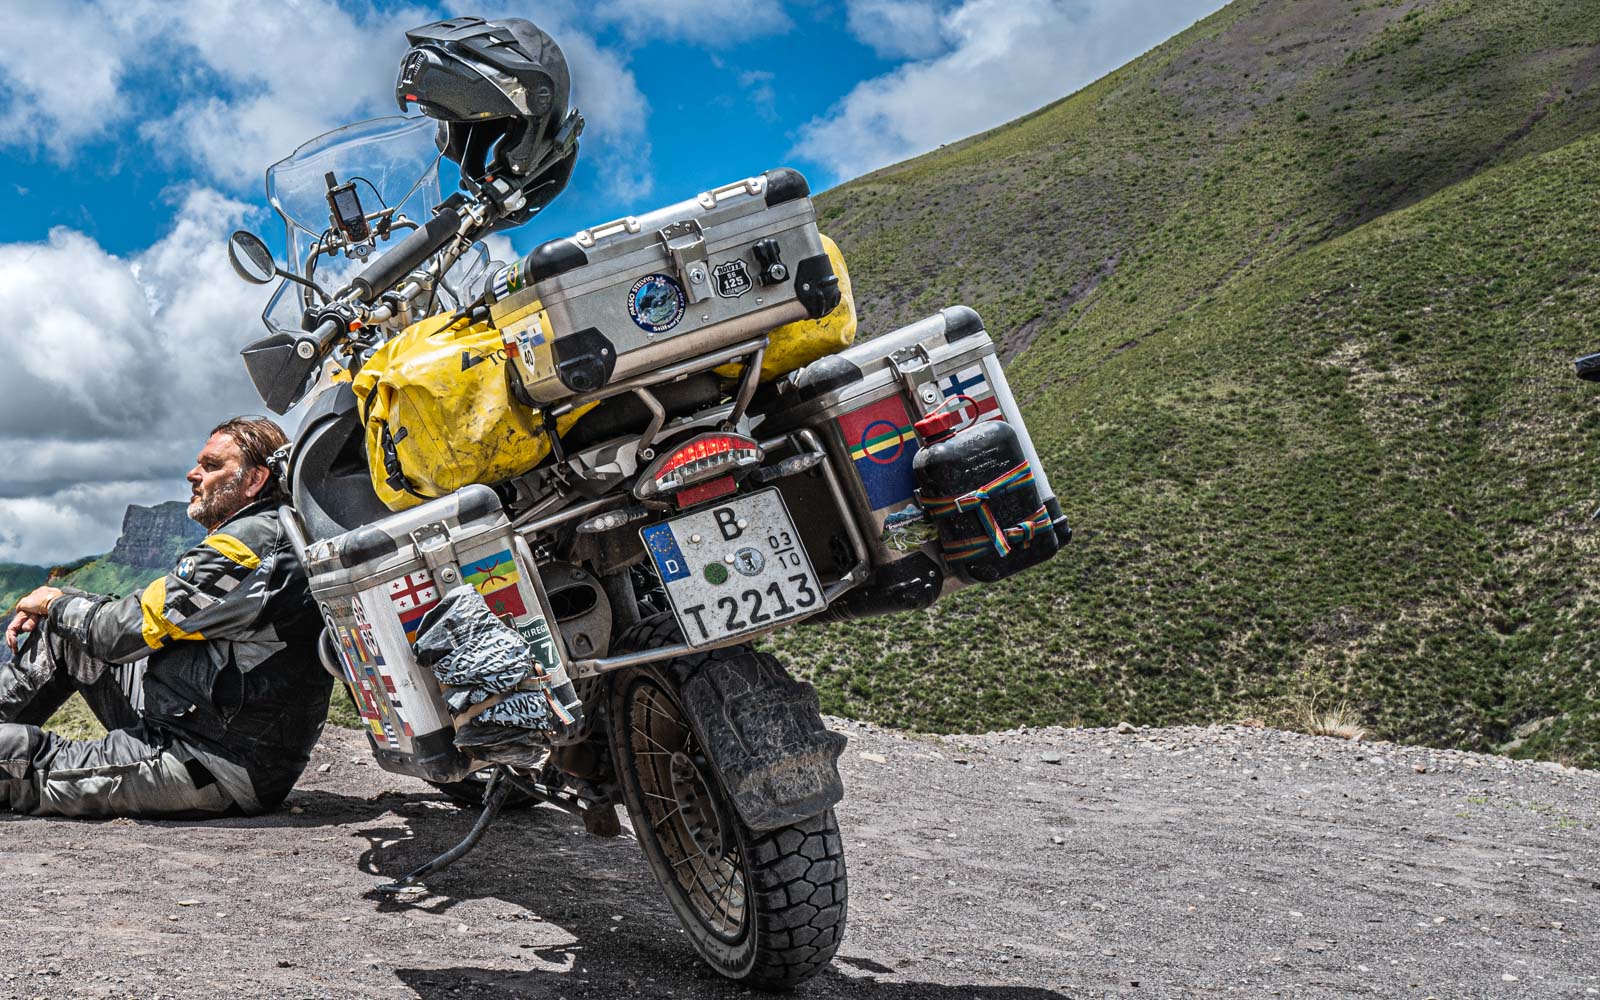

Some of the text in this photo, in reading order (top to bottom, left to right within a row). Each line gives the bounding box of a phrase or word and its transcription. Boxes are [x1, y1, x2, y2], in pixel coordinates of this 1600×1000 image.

[717, 261, 743, 275] ROUTE
[723, 276, 744, 290] 125
[628, 275, 655, 316] PASSO STELVIO
[524, 349, 534, 367] 40
[713, 507, 744, 541] B
[768, 531, 792, 549] 03
[665, 559, 680, 574] D
[778, 552, 801, 569] 10
[683, 572, 816, 639] T 2213
[540, 641, 554, 665] 7
